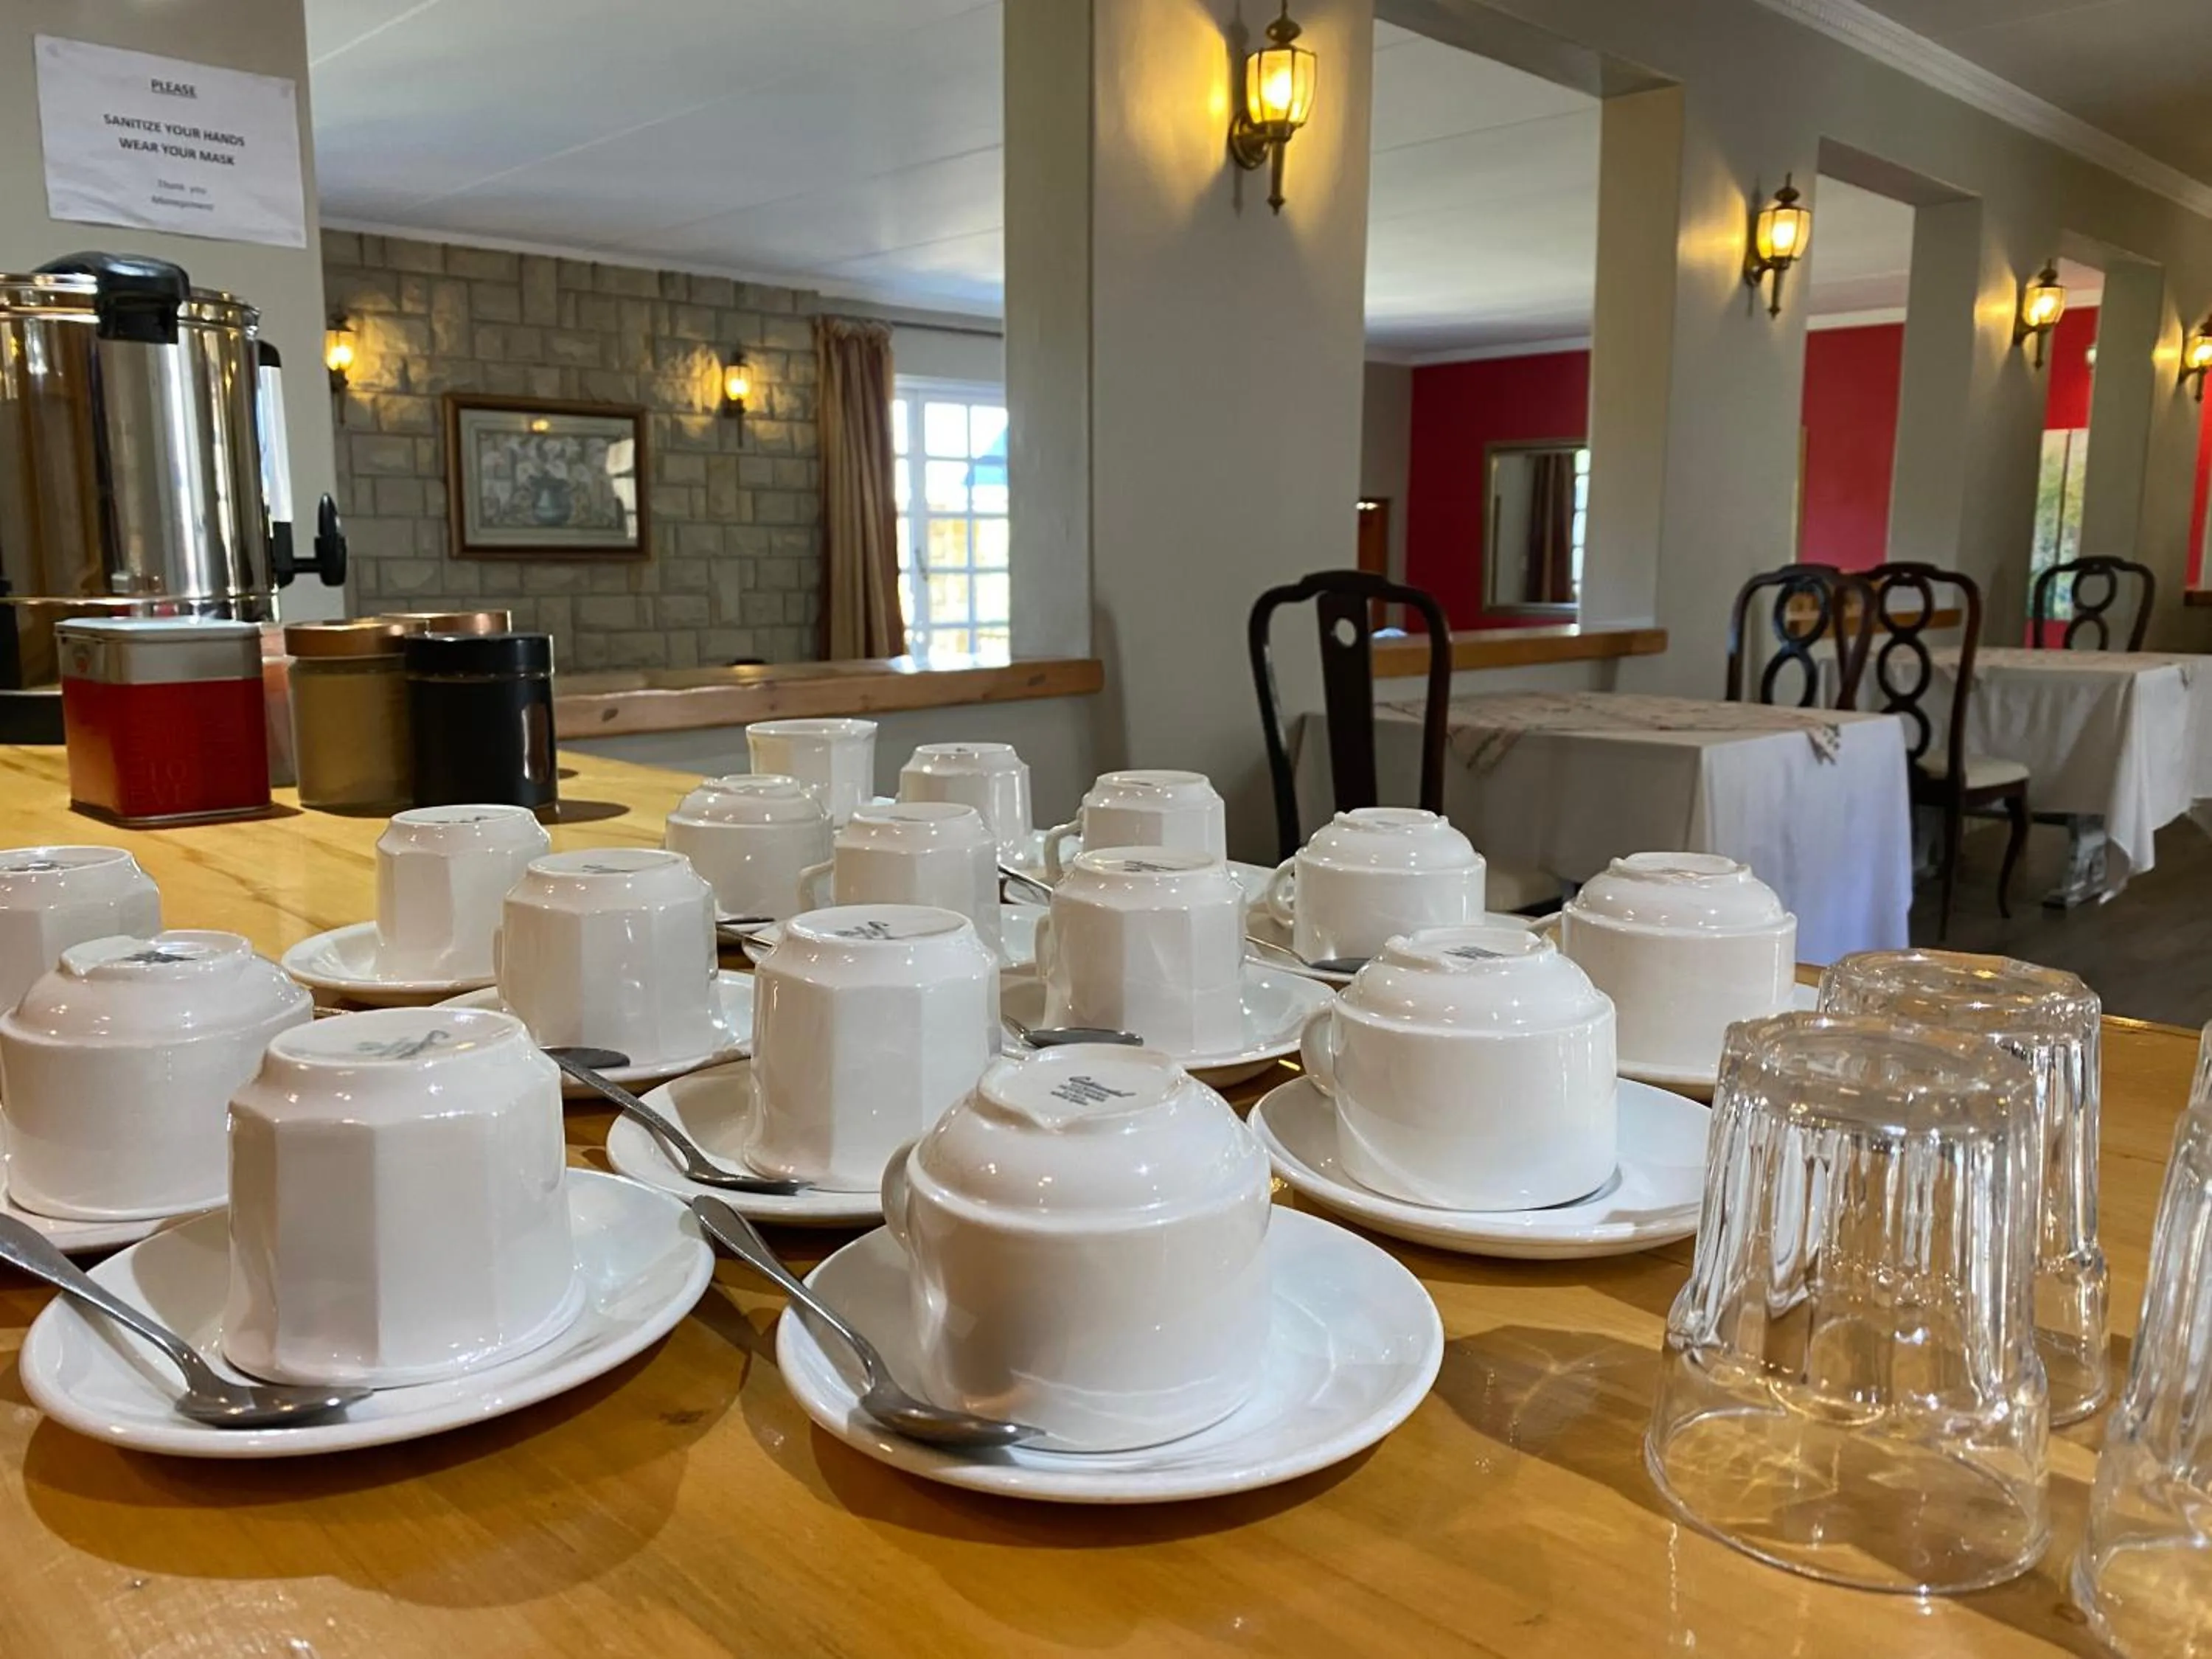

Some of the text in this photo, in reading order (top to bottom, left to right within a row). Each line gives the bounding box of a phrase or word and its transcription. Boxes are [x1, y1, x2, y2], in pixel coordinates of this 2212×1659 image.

[151, 79, 197, 98] PLEASE
[103, 114, 245, 147] SANITIZE YOUR HANDS
[119, 138, 234, 165] WEAR YOUR MASK
